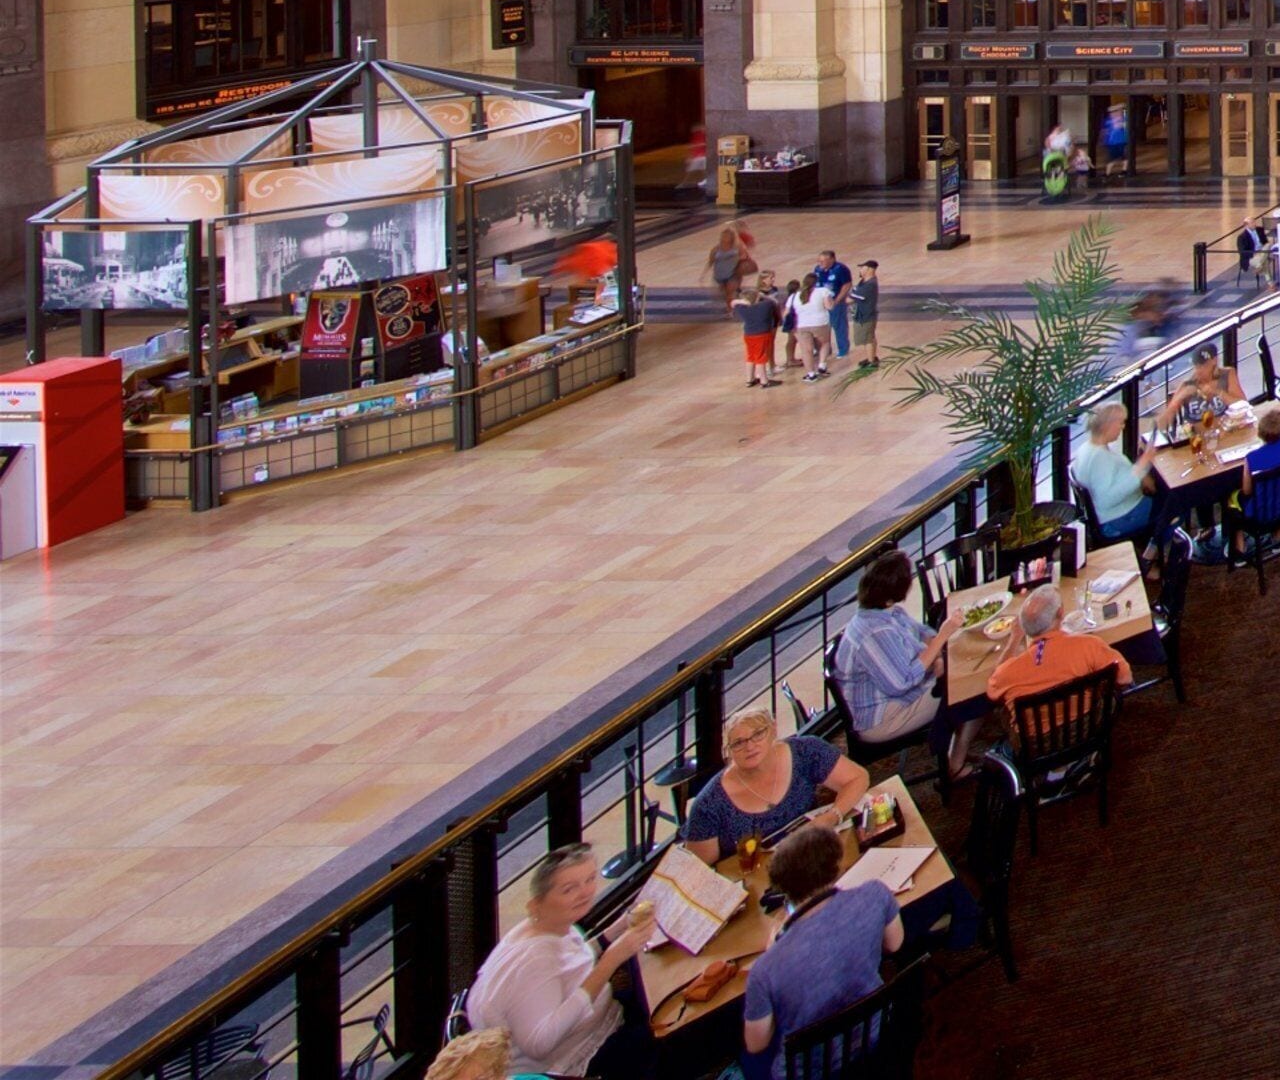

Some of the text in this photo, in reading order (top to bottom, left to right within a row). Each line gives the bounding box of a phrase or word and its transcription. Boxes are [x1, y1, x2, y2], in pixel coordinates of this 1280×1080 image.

[1075, 47, 1111, 55] SCIENCE
[218, 80, 292, 98] RESTROOMS
[156, 105, 175, 114] IRS
[177, 102, 196, 110] AND
